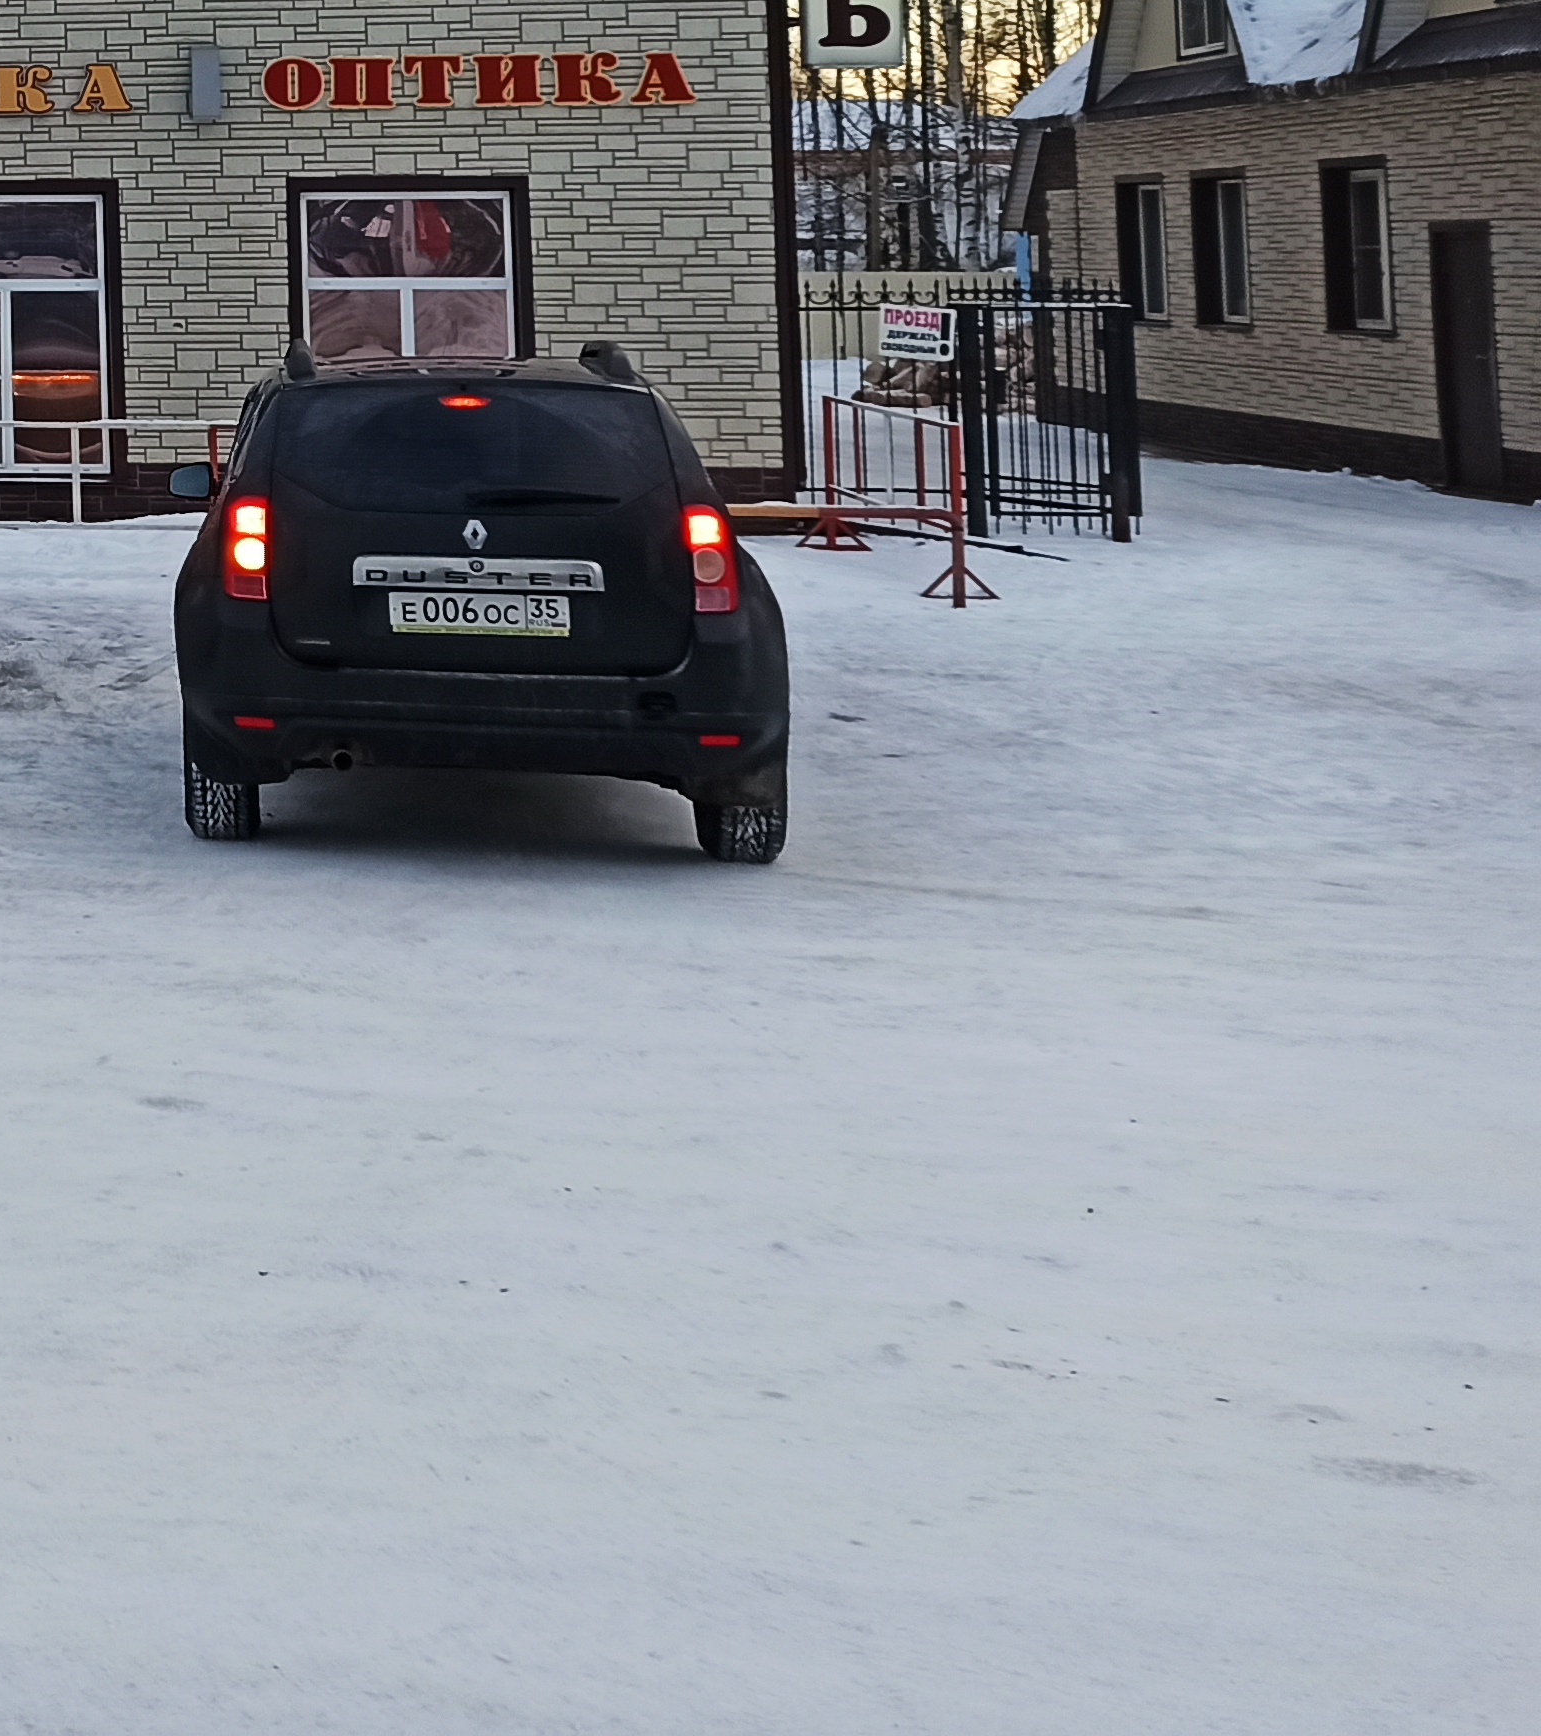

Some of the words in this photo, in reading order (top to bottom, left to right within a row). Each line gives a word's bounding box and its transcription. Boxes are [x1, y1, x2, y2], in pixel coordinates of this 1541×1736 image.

[262, 50, 697, 110] ОПТИКА
[884, 308, 940, 332] ПРОЕЗД
[366, 569, 593, 587] DUSTER
[529, 598, 559, 619] 35
